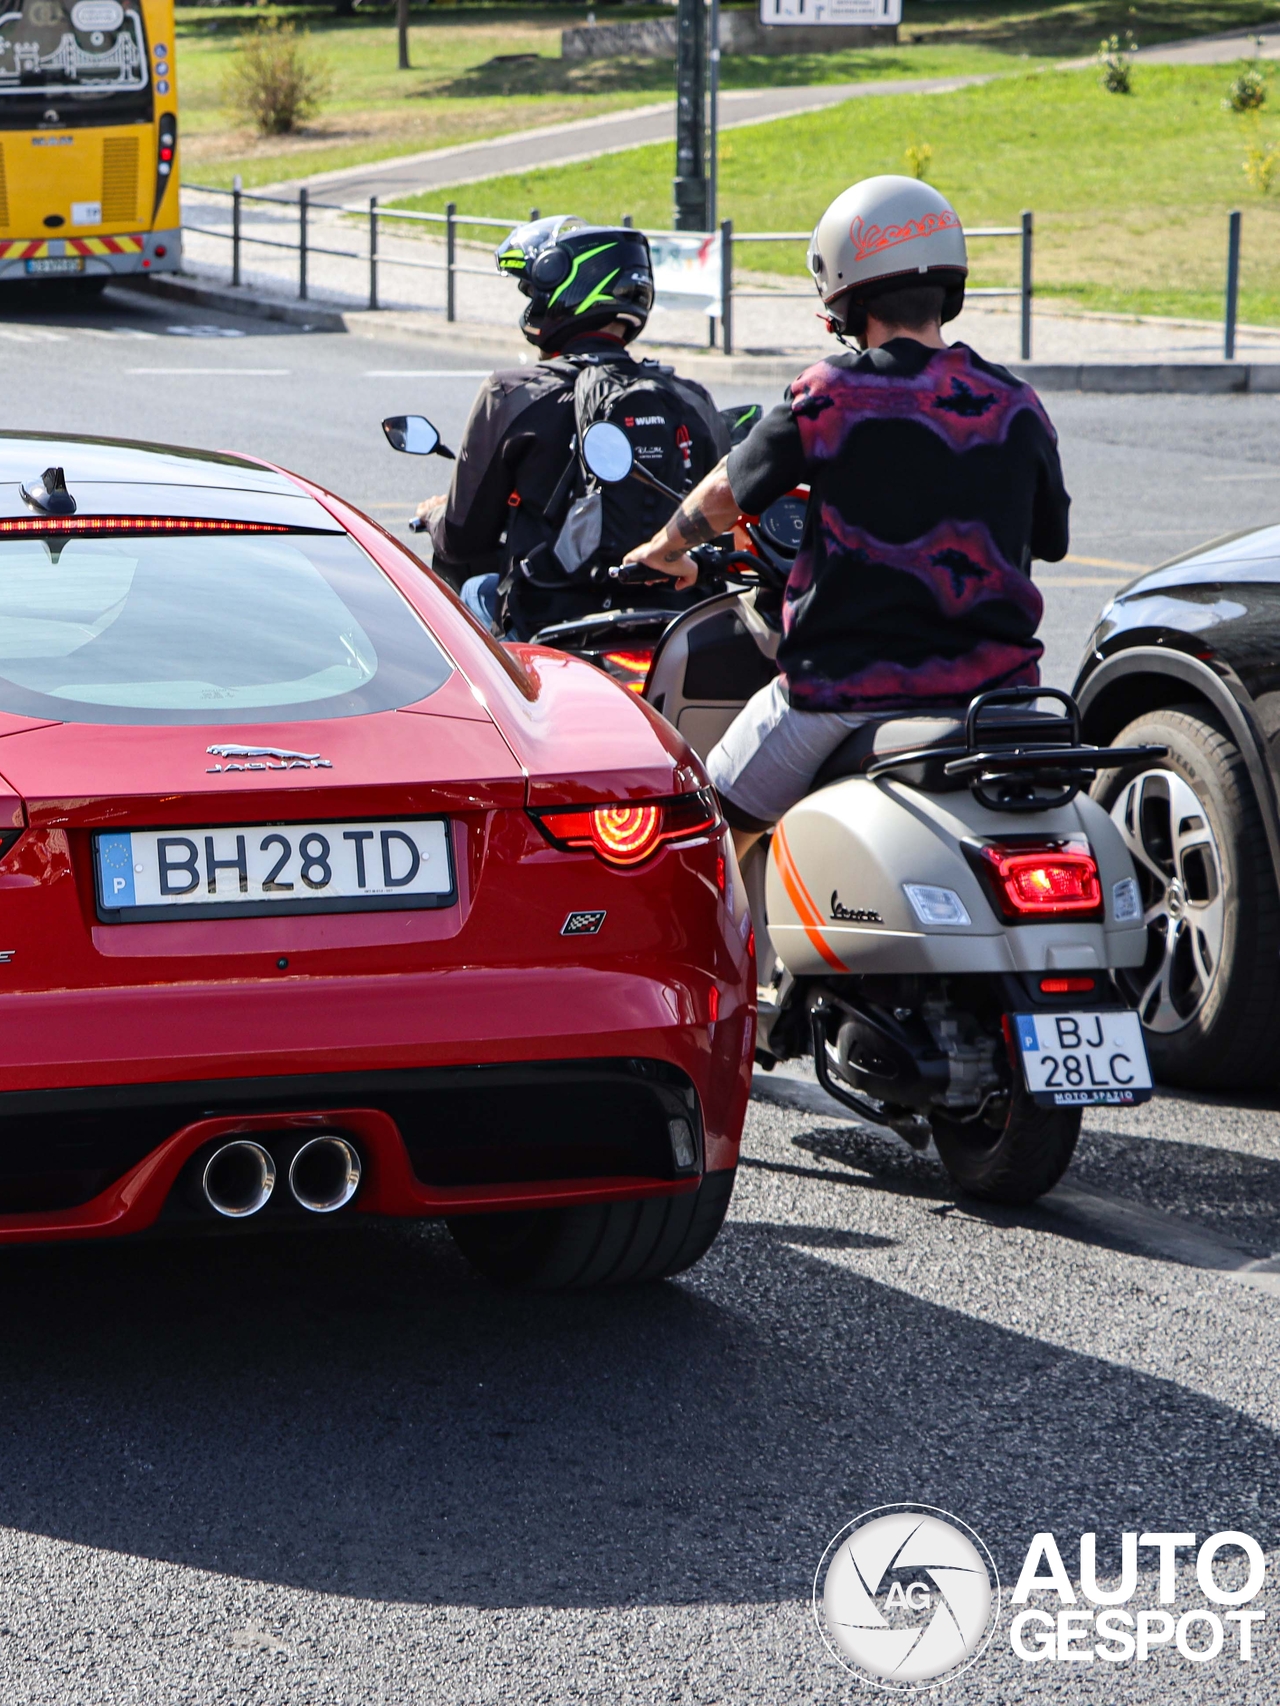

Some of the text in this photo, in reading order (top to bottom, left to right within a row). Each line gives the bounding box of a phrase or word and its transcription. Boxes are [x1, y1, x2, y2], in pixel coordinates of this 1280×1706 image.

[850, 210, 961, 261] Vespa
[205, 760, 333, 773] JAGUAR
[113, 877, 126, 894] P
[830, 889, 884, 924] Vespa
[1025, 1037, 1034, 1048] P
[1055, 1016, 1104, 1050] BJ
[1040, 1053, 1135, 1088] 28LC
[1054, 1091, 1133, 1100] MOTO SPAZIO
